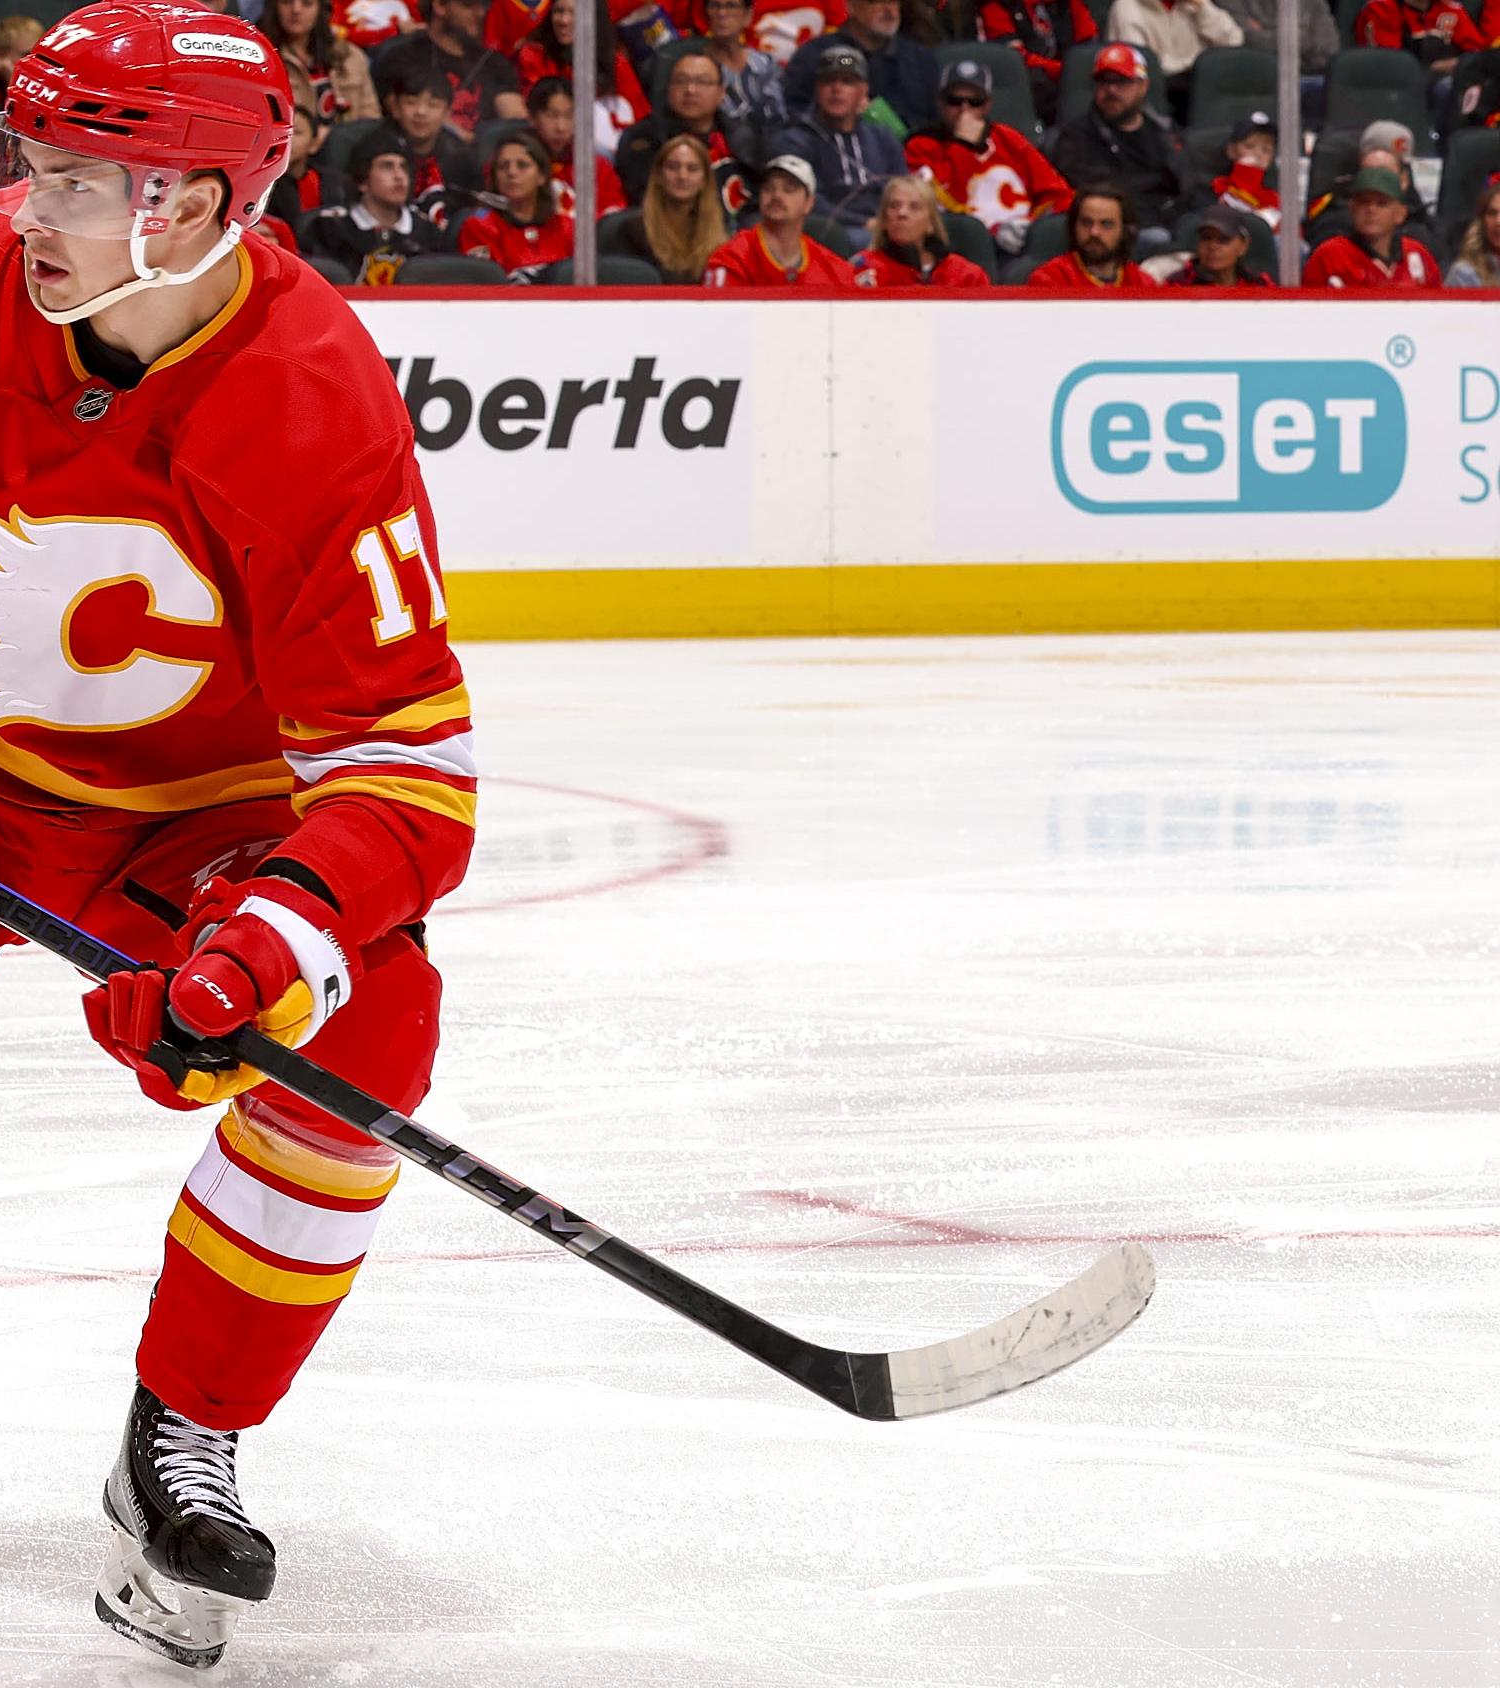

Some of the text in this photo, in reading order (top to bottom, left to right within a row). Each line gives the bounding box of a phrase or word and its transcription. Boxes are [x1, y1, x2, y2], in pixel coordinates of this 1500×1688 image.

[14, 74, 60, 102] CCM
[385, 357, 741, 451] berta
[350, 505, 450, 648] 17
[320, 927, 351, 968] SHARKY
[191, 974, 234, 1010] CCM
[367, 1109, 613, 1258] CCM
